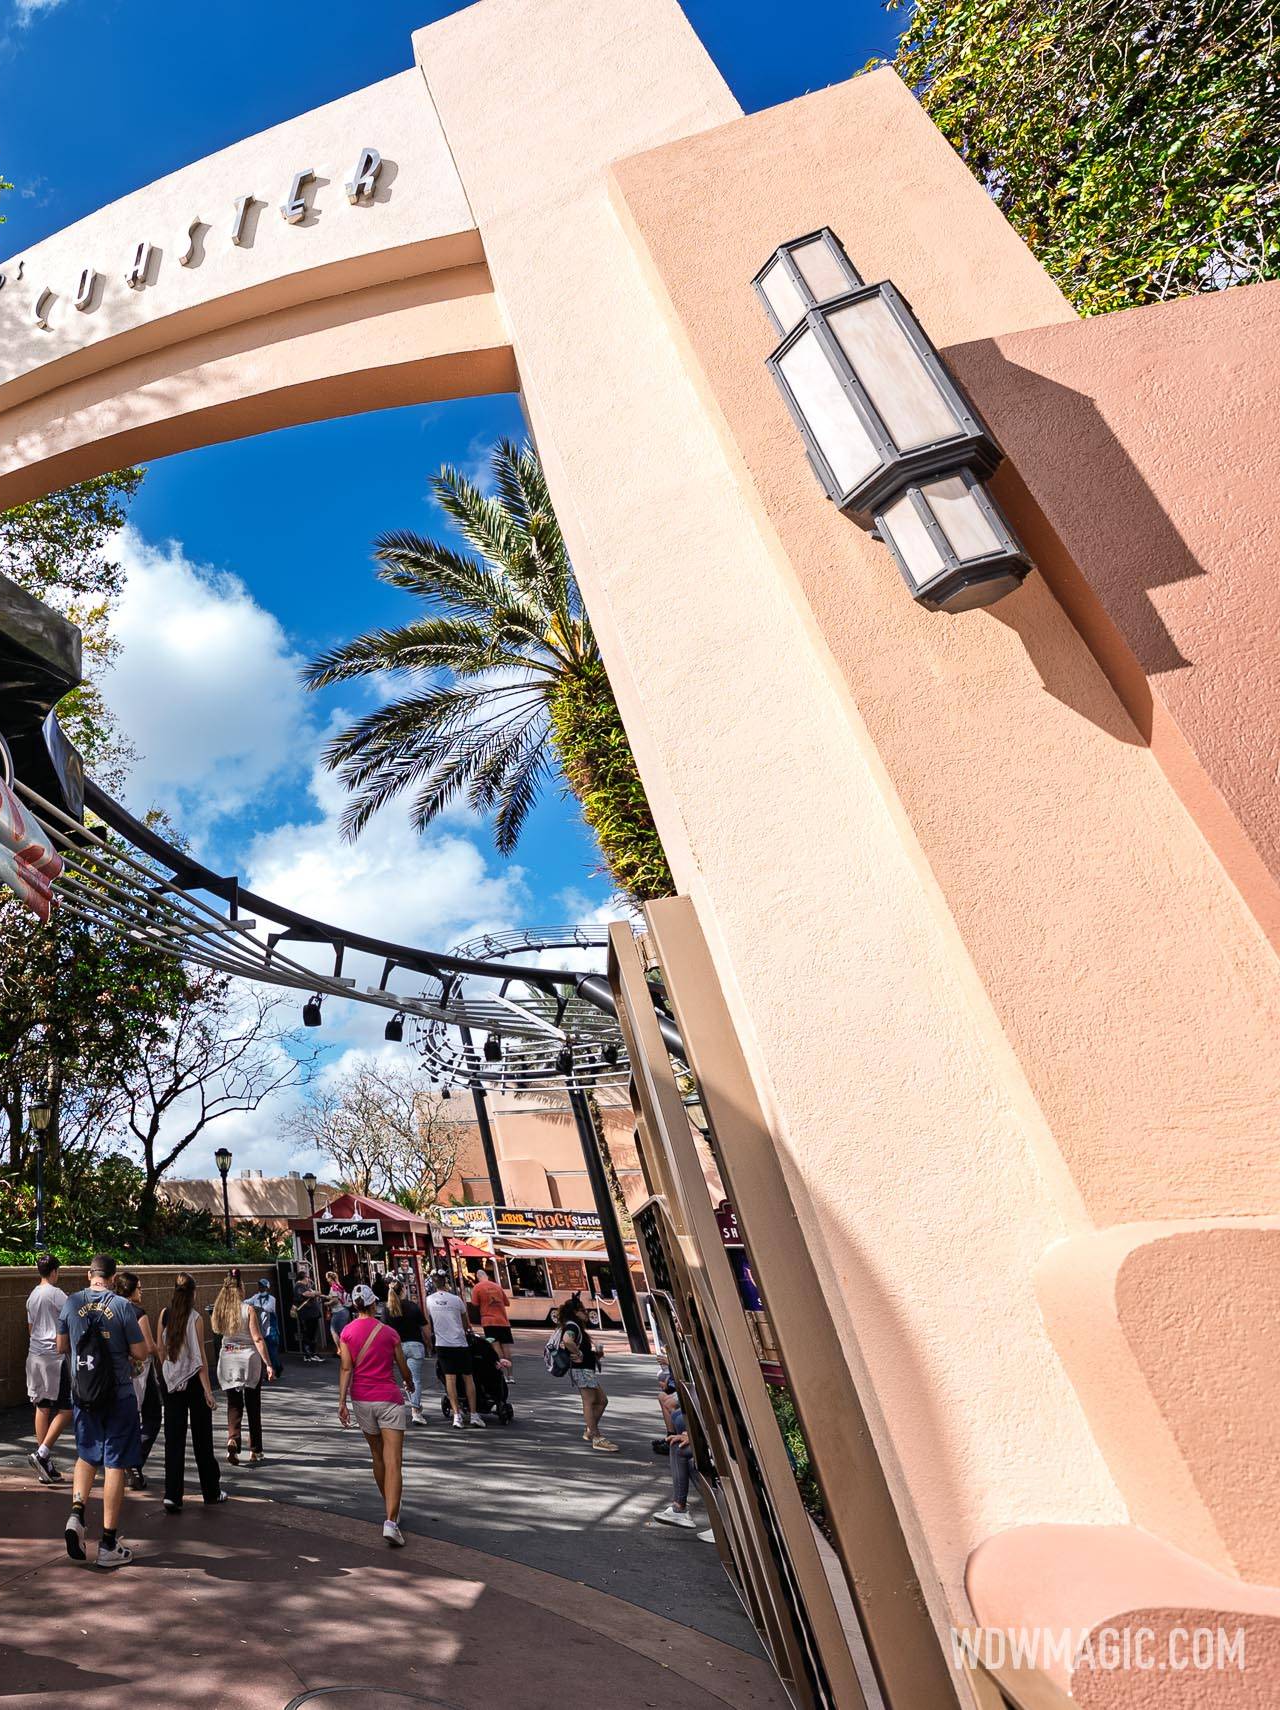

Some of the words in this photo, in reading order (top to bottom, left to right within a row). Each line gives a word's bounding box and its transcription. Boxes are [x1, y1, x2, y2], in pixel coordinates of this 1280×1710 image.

[35, 147, 384, 331] COASTER
[534, 1213, 575, 1229] ROCK
[571, 1216, 601, 1226] Statio
[320, 1224, 339, 1235] ROCK
[339, 1224, 358, 1236] YOUR
[356, 1226, 376, 1238] FACE
[723, 1228, 739, 1239] SH
